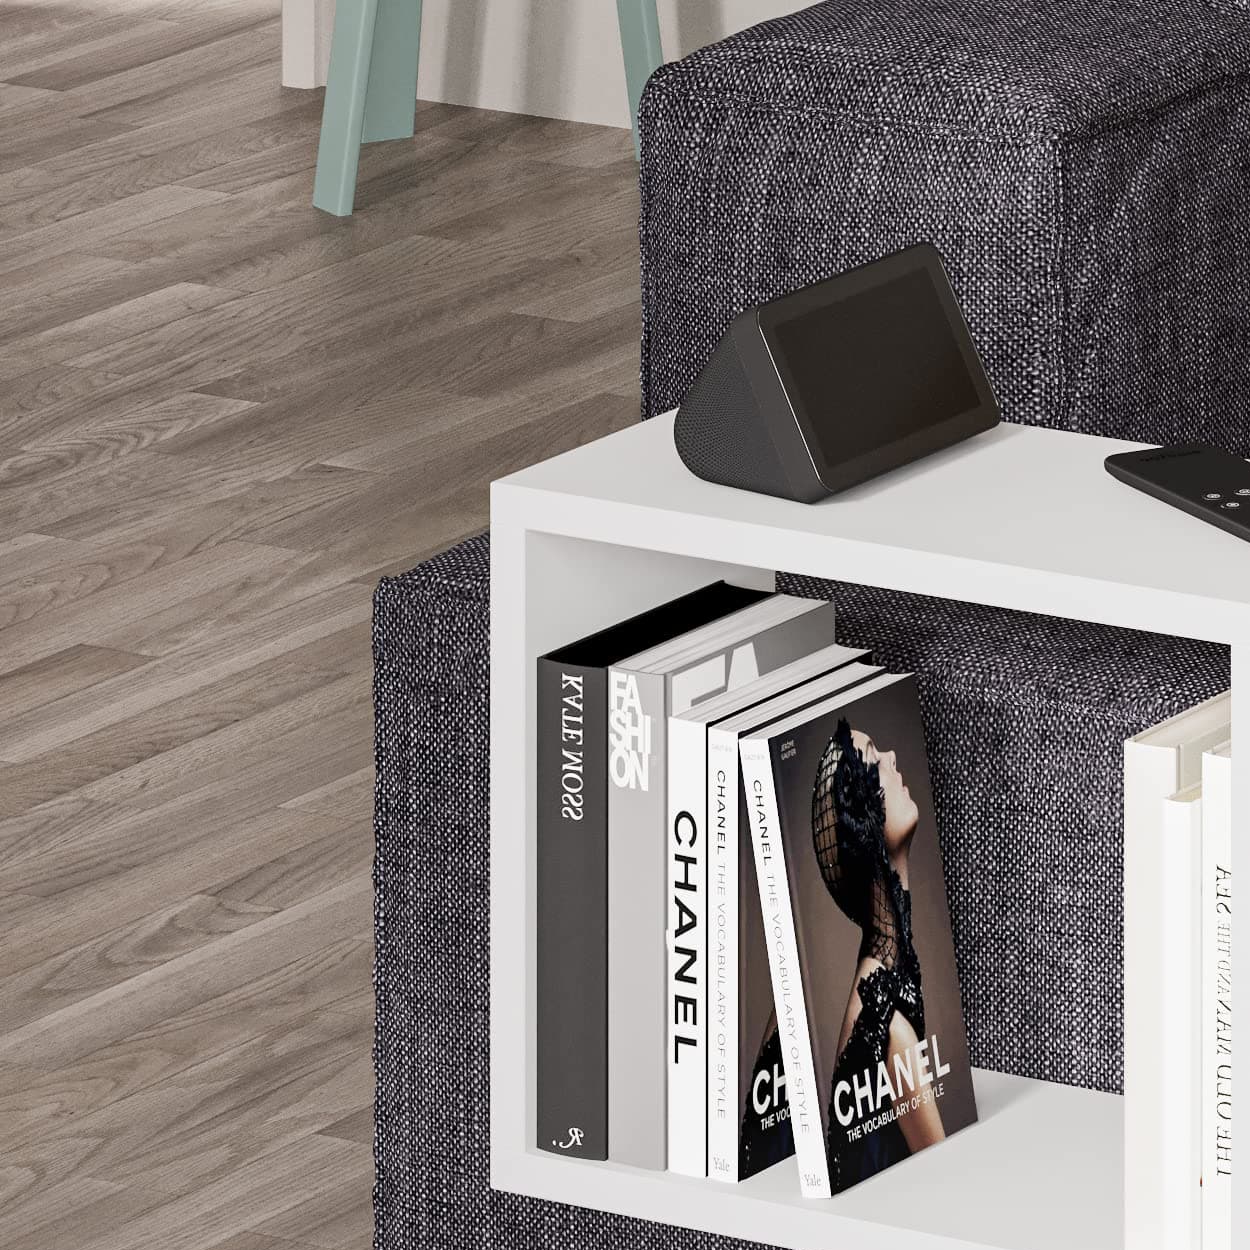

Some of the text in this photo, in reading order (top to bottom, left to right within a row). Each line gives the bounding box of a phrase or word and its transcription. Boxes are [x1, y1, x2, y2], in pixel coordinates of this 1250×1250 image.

[674, 810, 698, 1064] CHANEL
[717, 770, 727, 1119] CHANEL THE VOCABULARY OF STYLE
[753, 779, 810, 1134] CHANEL THE VOCABULARY OF STYLE
[834, 1035, 950, 1126] CHANEL
[847, 1083, 945, 1143] THE VOCABULARY OF STYLE
[760, 1113, 775, 1131] THE
[713, 1156, 730, 1173] Yale
[803, 1174, 821, 1187] Yale
